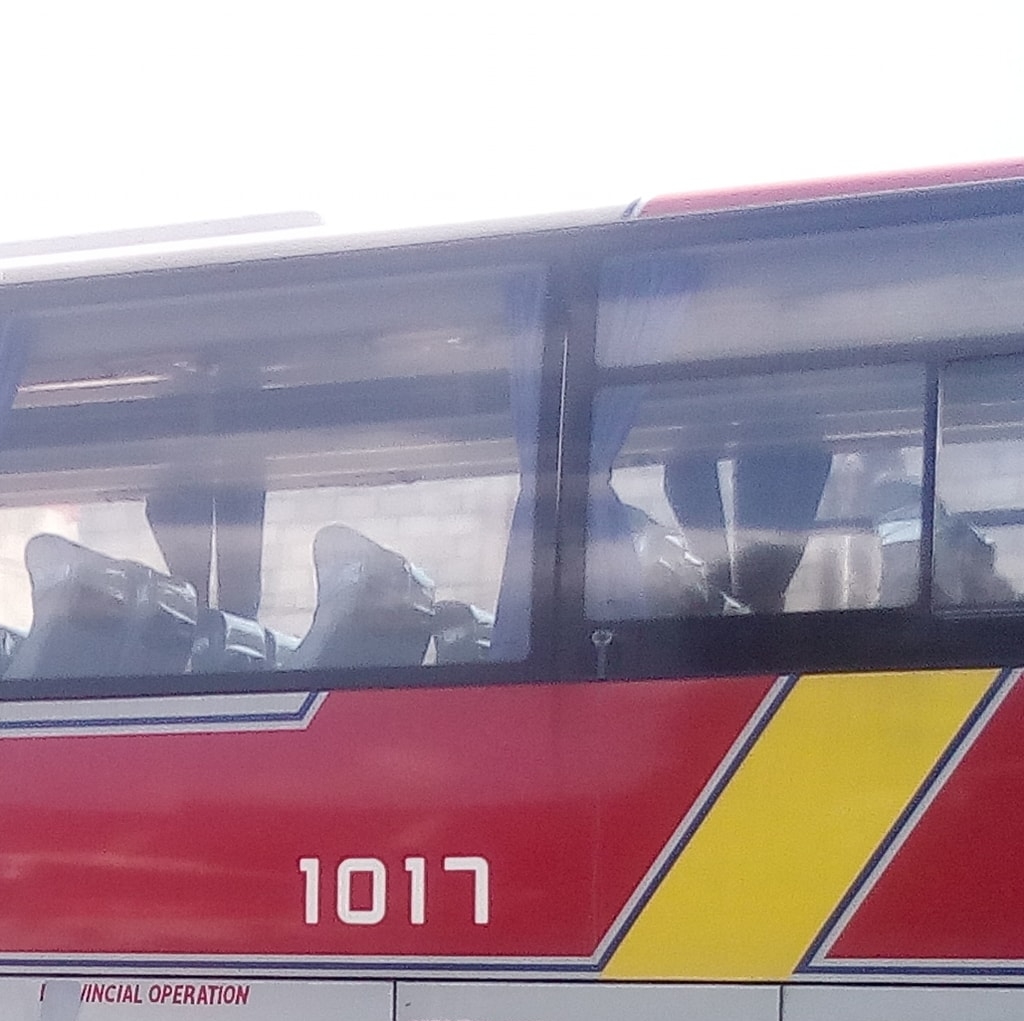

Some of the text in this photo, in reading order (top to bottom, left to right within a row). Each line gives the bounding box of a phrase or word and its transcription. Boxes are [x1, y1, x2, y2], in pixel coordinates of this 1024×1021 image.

[299, 856, 489, 924] 1017
[40, 983, 250, 1005] INCIAL OPERATION
